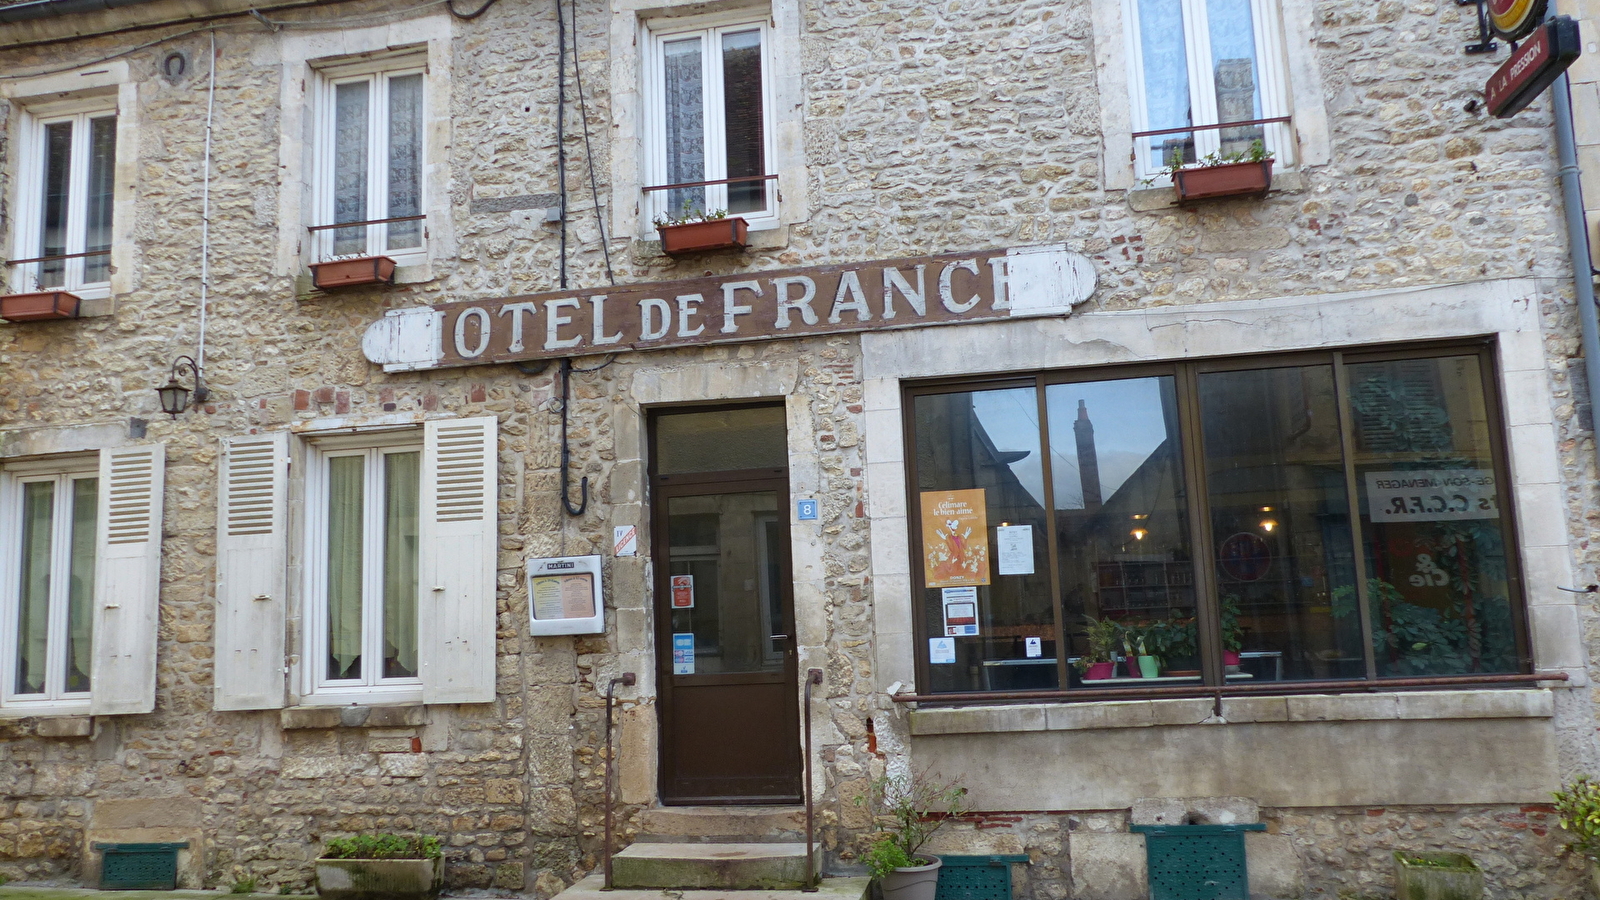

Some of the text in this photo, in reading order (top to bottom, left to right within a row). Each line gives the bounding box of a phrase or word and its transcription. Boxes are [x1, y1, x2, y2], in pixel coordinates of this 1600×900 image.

[1499, 75, 1508, 92] LA
[1510, 41, 1541, 81] PRESSION
[637, 293, 705, 342] DE
[803, 504, 811, 515] 8
[933, 508, 940, 516] le
[615, 527, 637, 553] LICENCE
